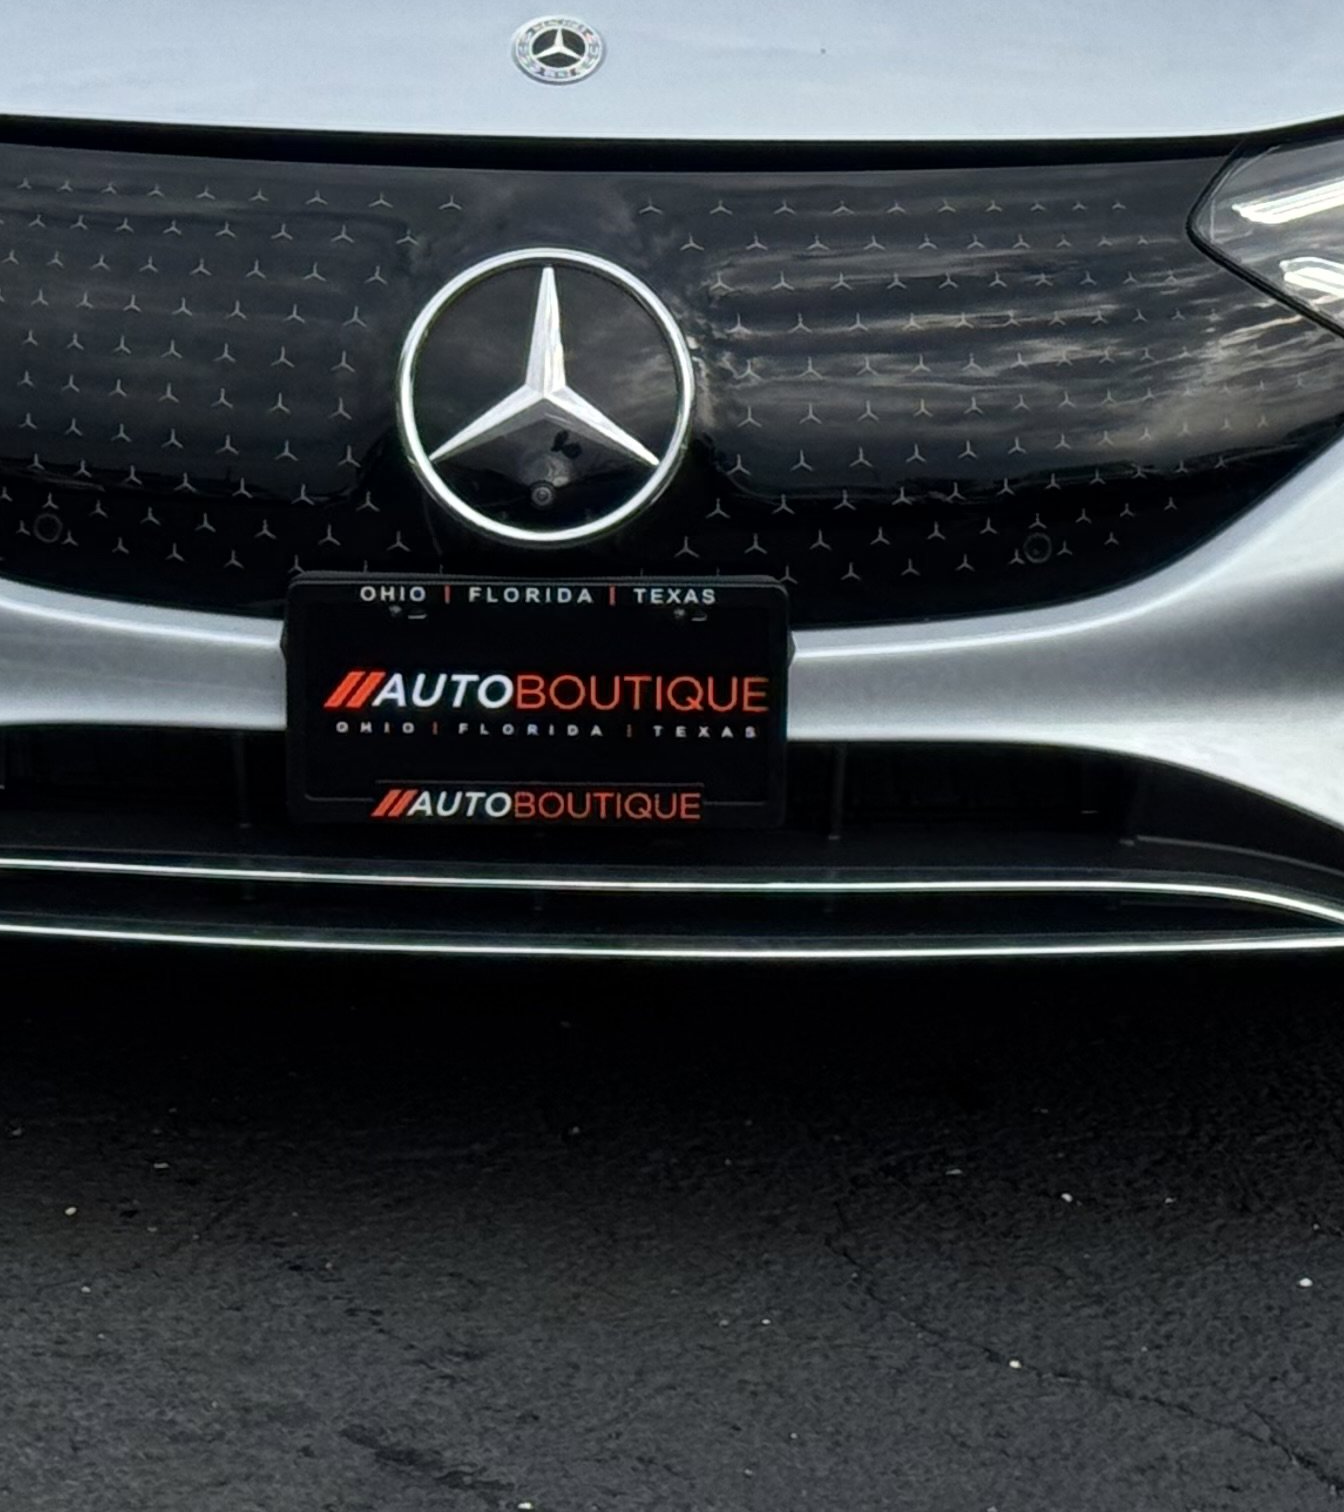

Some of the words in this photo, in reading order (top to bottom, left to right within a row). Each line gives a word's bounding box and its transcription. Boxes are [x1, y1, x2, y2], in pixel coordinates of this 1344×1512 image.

[359, 585, 427, 603] OHIO
[468, 587, 594, 605] FLORIDA
[632, 588, 717, 605] TEXAS
[335, 720, 415, 734] OHIO
[458, 722, 604, 737] FLORIDA
[653, 724, 757, 739] TEXAS
